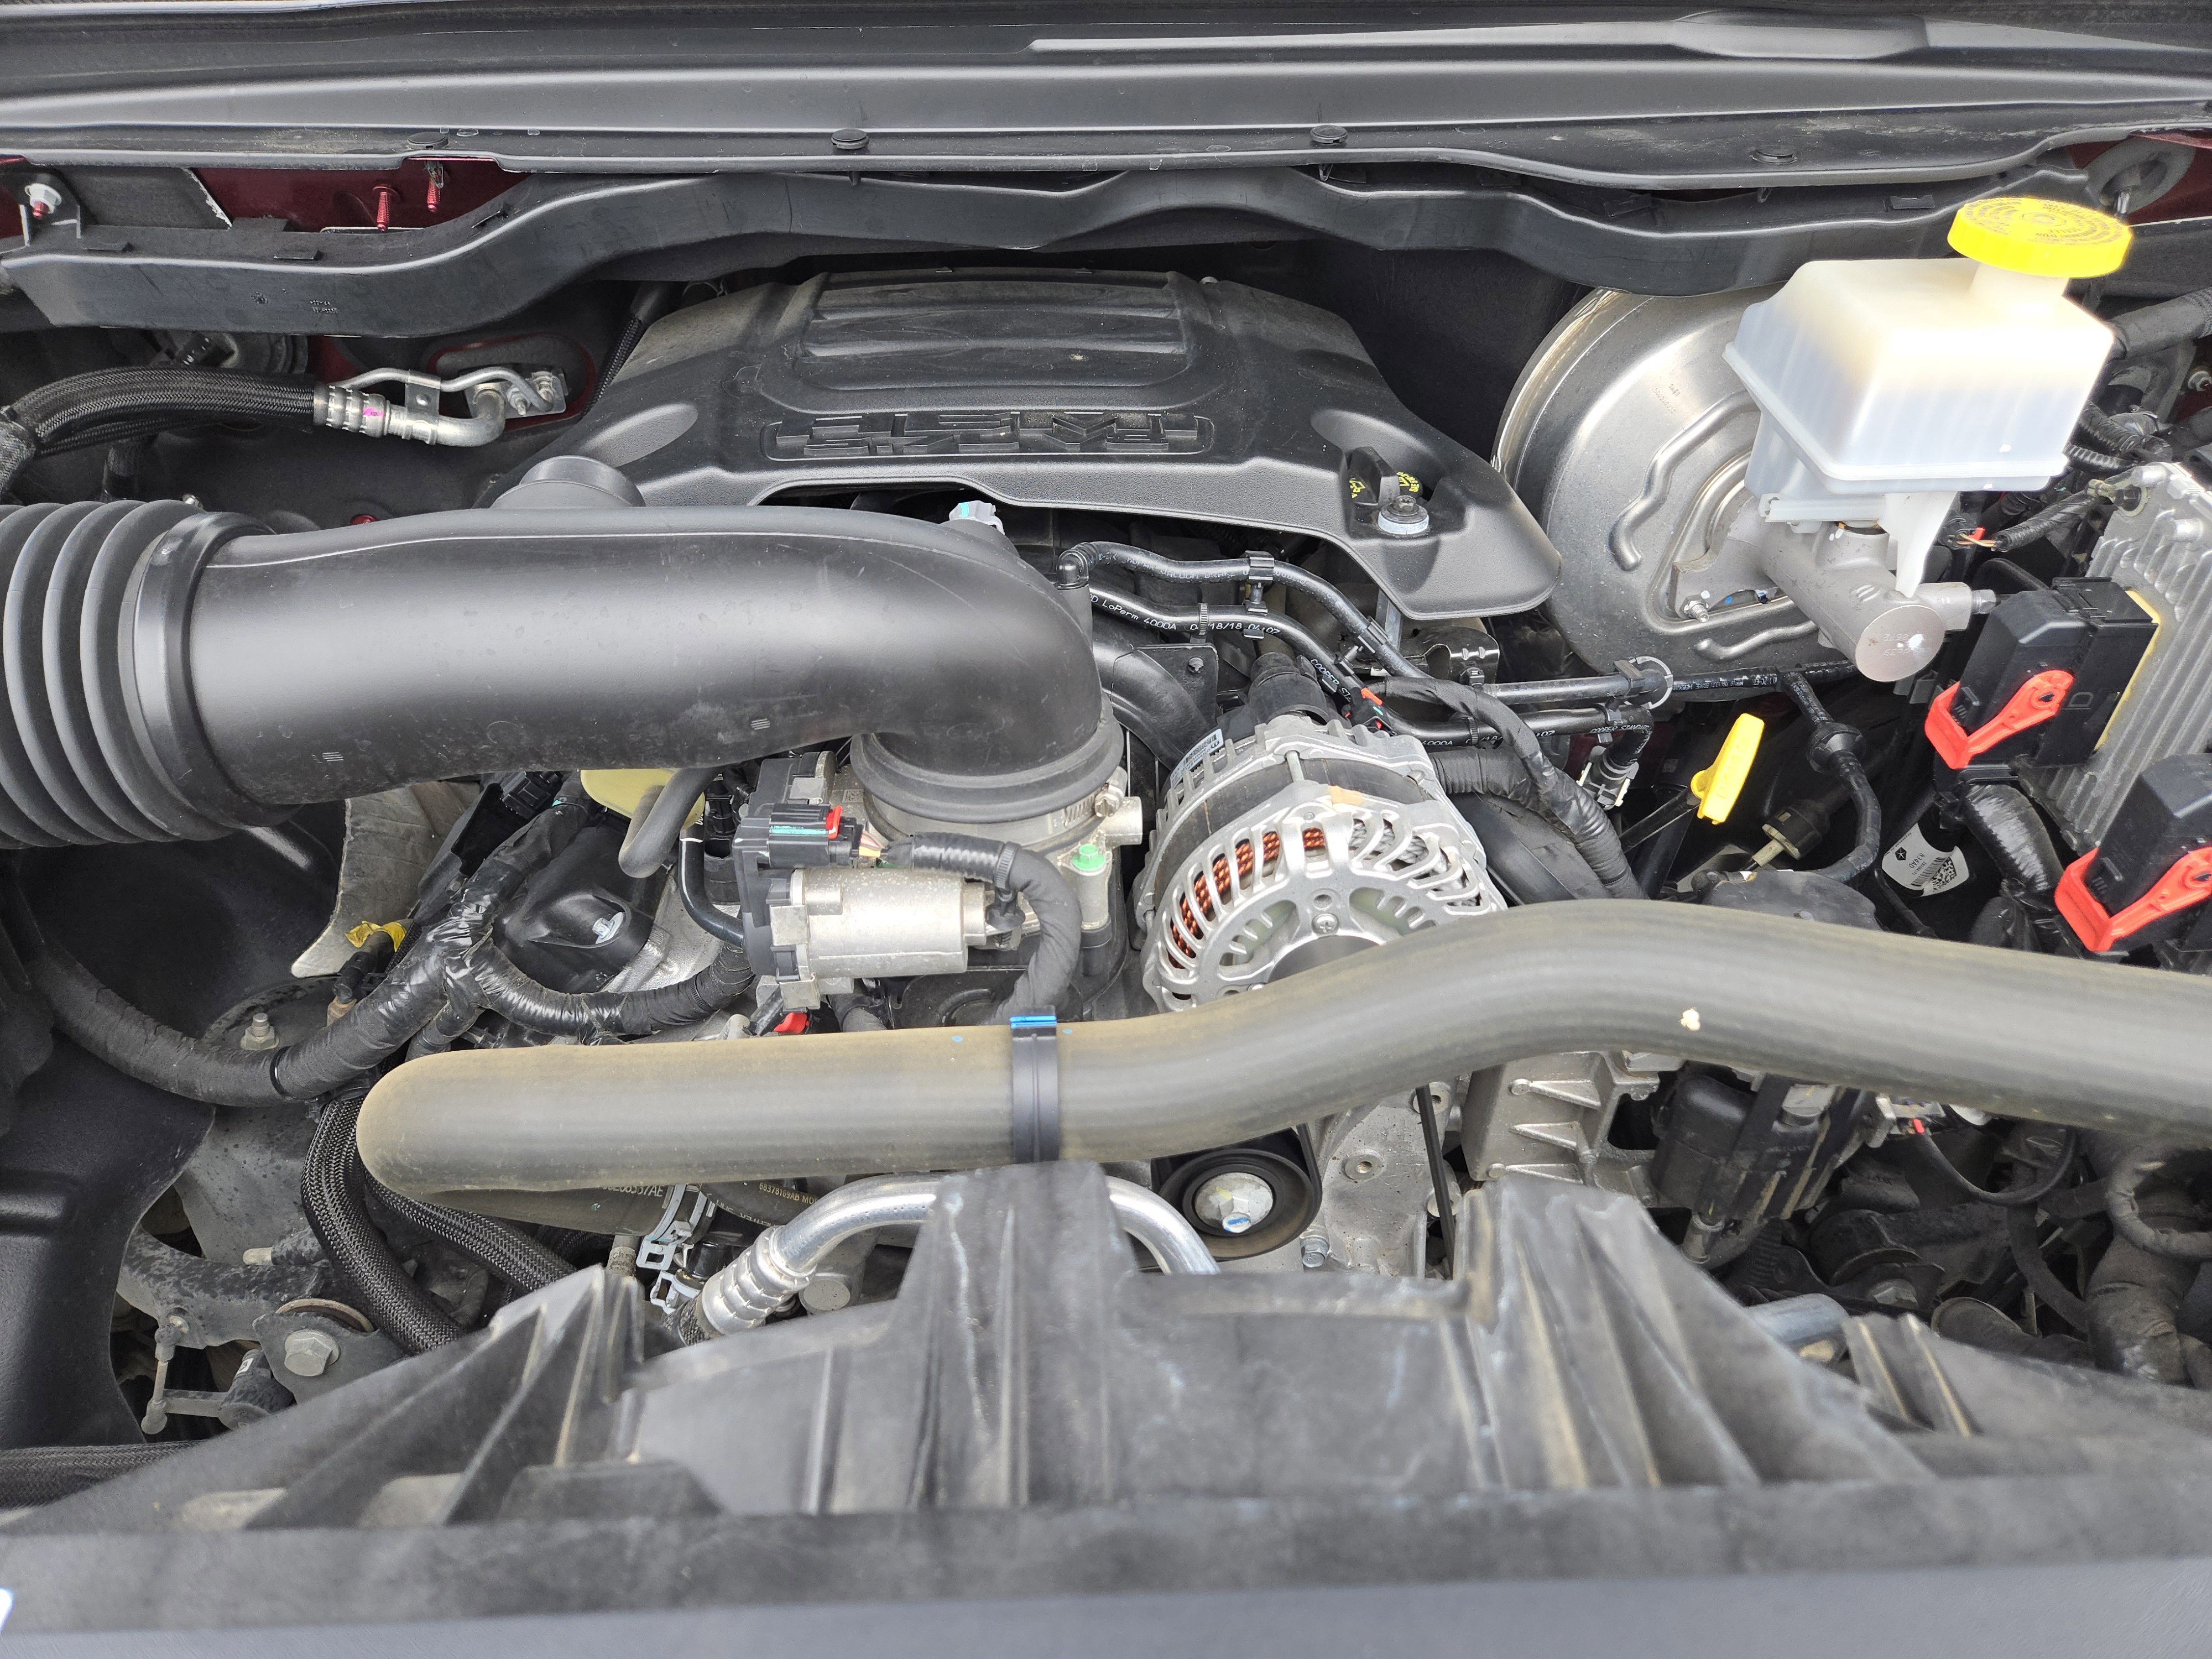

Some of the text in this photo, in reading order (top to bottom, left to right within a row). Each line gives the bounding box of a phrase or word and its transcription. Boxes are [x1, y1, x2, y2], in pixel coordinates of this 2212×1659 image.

[1102, 599, 1139, 620] LoPerm
[1143, 617, 1177, 630] 4000A
[1310, 659, 1340, 685] COOPER
[759, 1182, 800, 1201] 68378169AB
